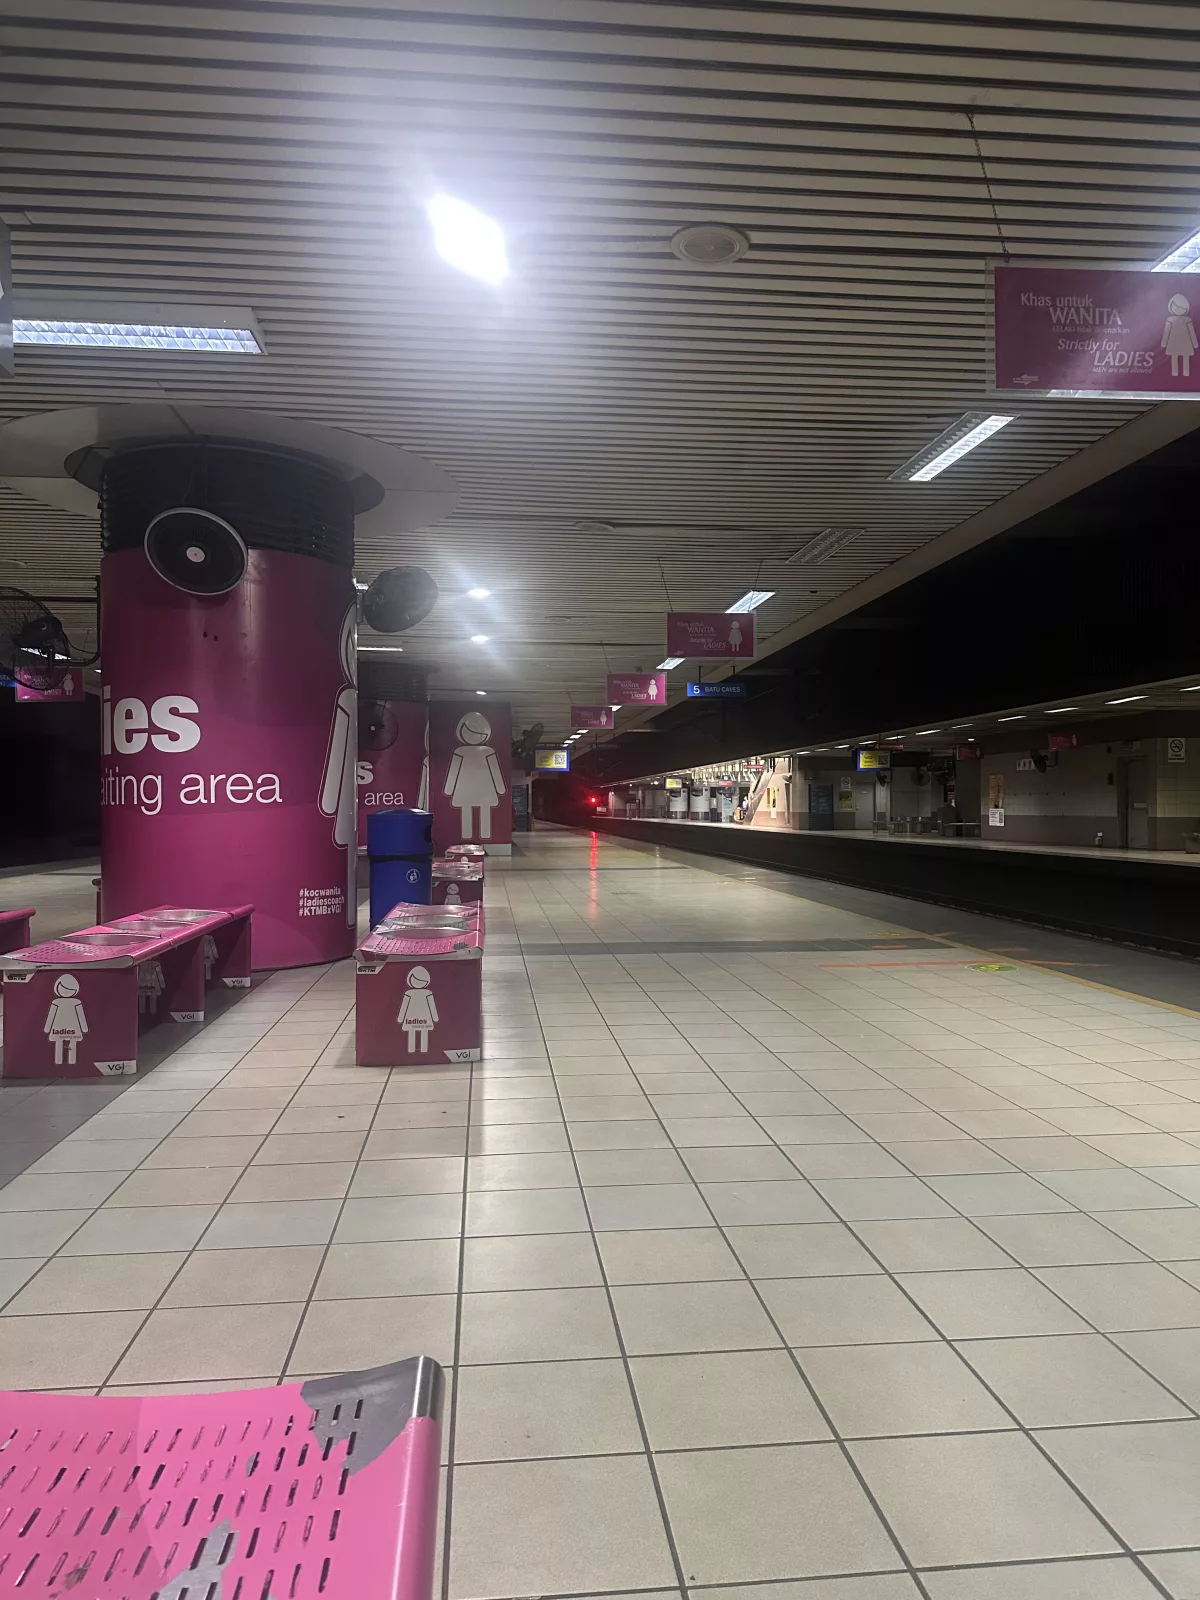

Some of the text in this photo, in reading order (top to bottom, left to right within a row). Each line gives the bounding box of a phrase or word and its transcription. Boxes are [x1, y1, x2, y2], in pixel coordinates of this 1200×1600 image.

[1021, 292, 1093, 307] Khas untuk
[1050, 307, 1122, 325] WANITA
[1058, 338, 1121, 353] Strictly for
[1093, 351, 1154, 366] LADIES
[687, 626, 715, 634] WANITA
[693, 685, 701, 694] 5
[101, 685, 201, 755] ies
[179, 773, 282, 804] area
[364, 792, 404, 806] area
[299, 886, 341, 897] #kocwanita
[299, 895, 345, 907] #ladiescoach
